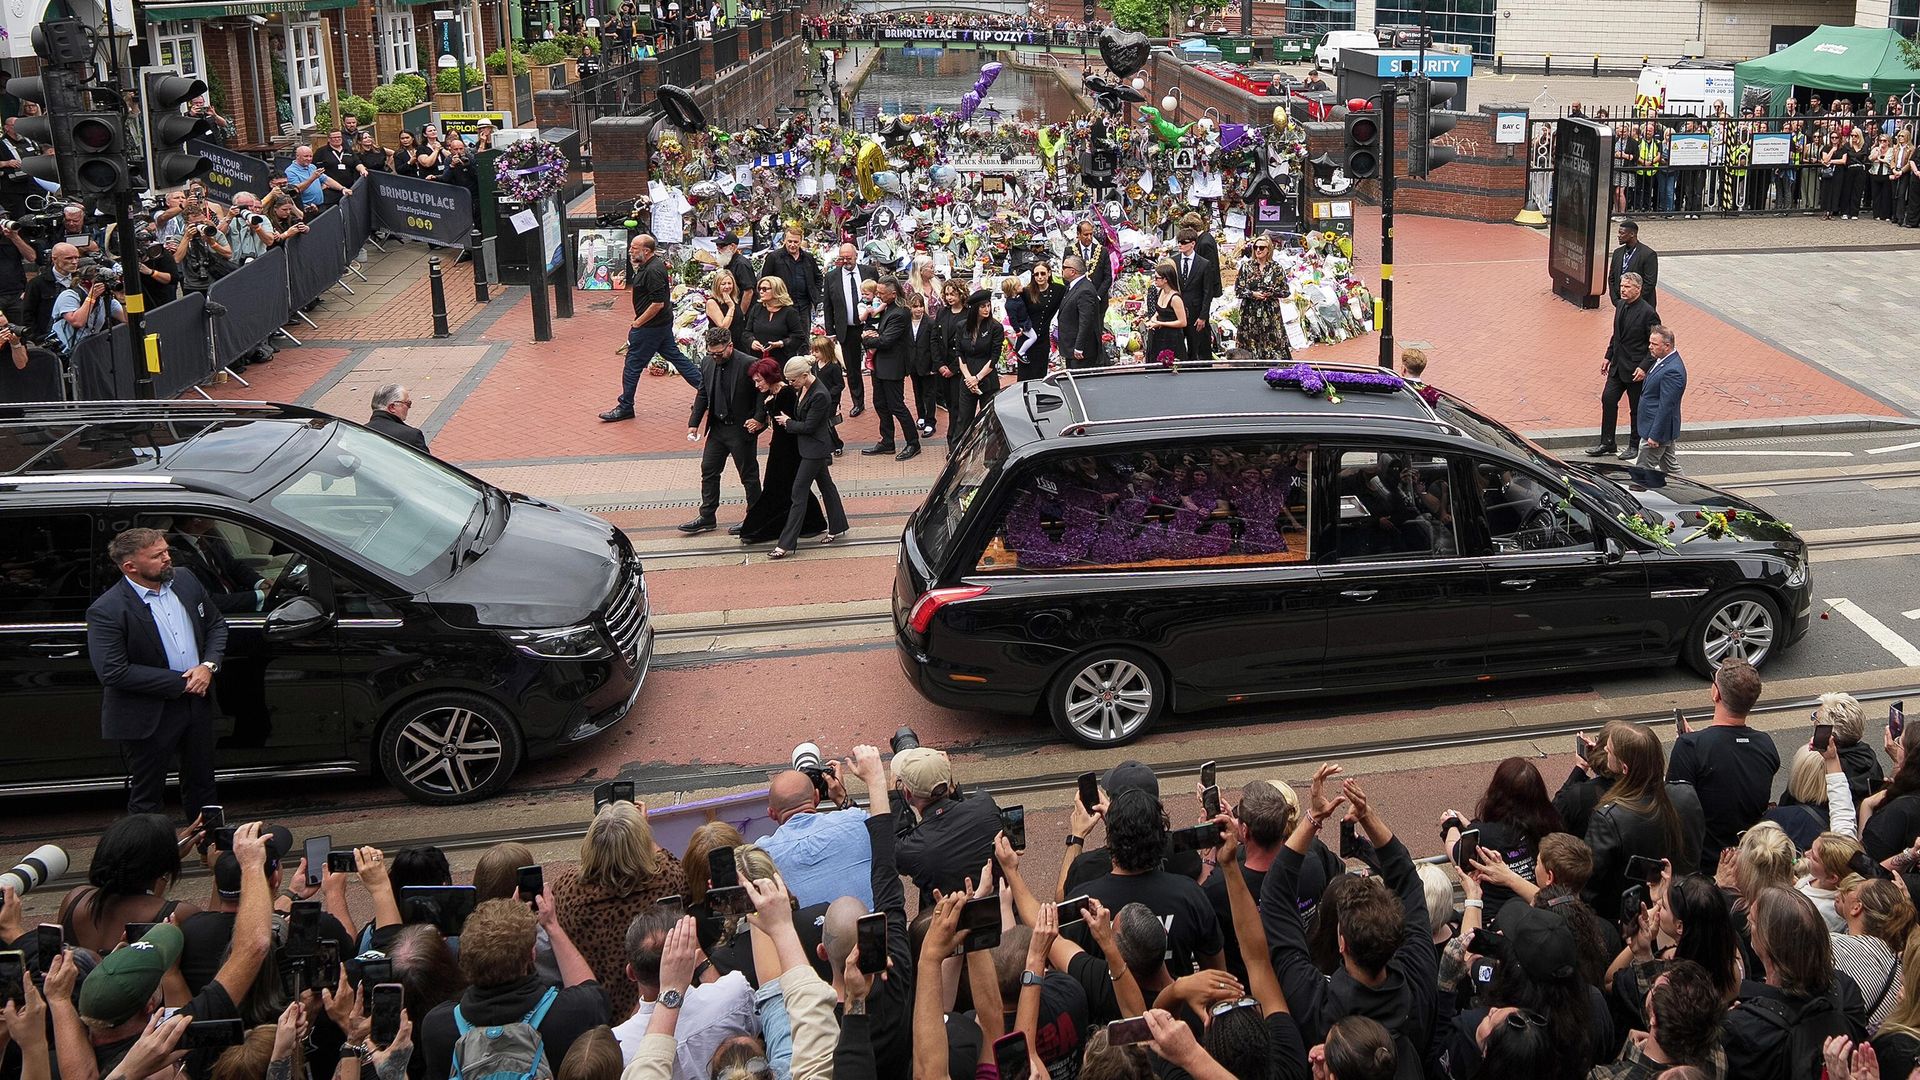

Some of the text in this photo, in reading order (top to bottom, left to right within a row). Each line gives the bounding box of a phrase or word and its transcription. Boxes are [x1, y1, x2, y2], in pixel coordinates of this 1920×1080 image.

[224, 2, 306, 16] TRADITIONAL FREE HOUSE
[884, 28, 1024, 42] BRINDLEYPLACE RIP OZZY
[1390, 60, 1460, 72] SCURITY
[1571, 142, 1586, 158] ZZY
[200, 150, 241, 171] SHARE YOUR
[212, 163, 252, 183] LEYMOMENT
[379, 184, 455, 210] BRINDLEYPLACE
[396, 204, 441, 219] brindleyplace.com
